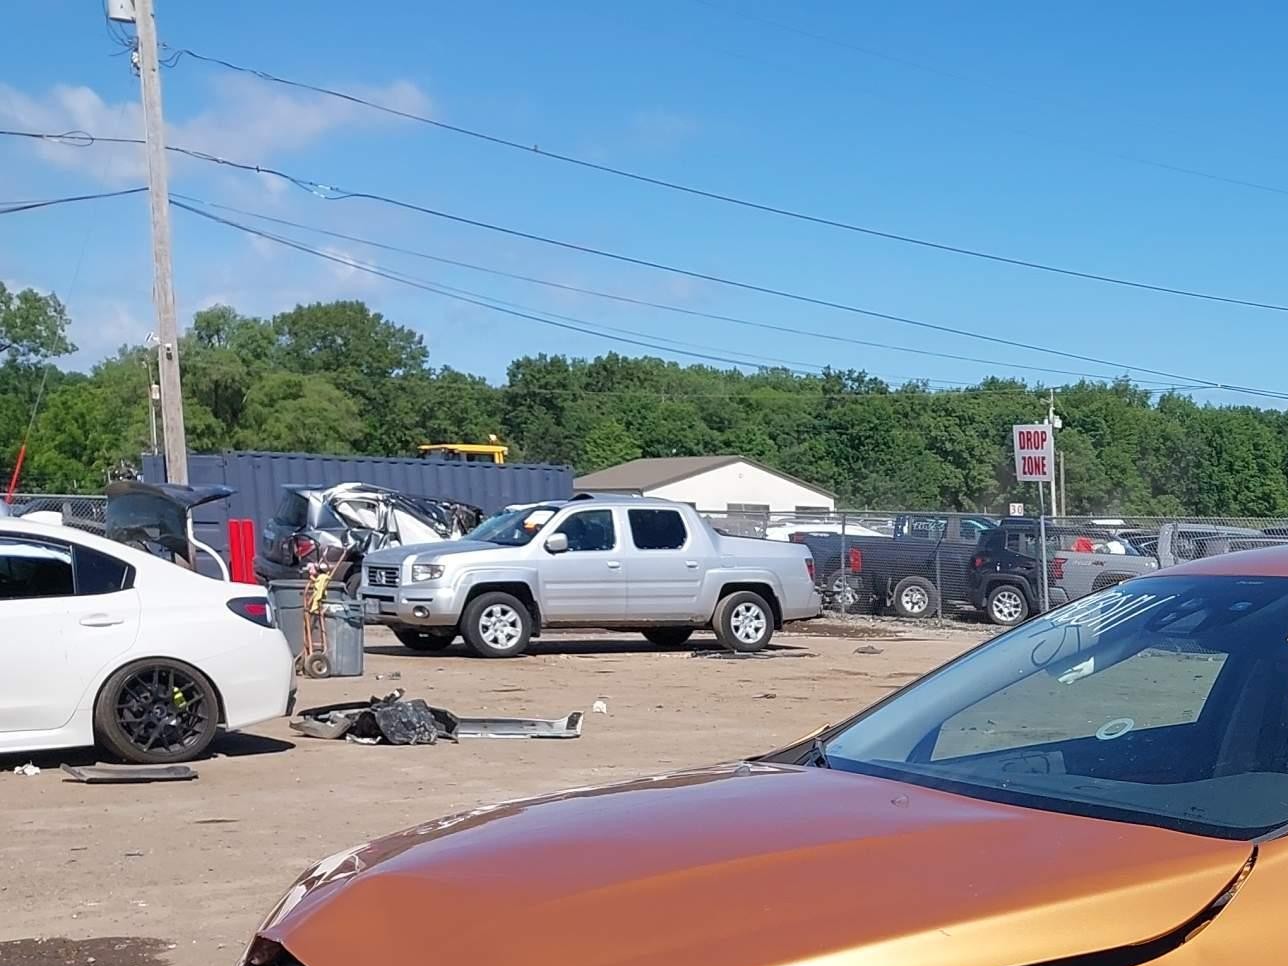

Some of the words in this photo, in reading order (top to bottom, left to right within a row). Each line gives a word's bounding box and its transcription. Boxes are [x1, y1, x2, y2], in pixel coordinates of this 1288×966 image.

[1018, 430, 1047, 450] DROP
[1021, 455, 1047, 476] ZONE
[1011, 504, 1024, 515] 30
